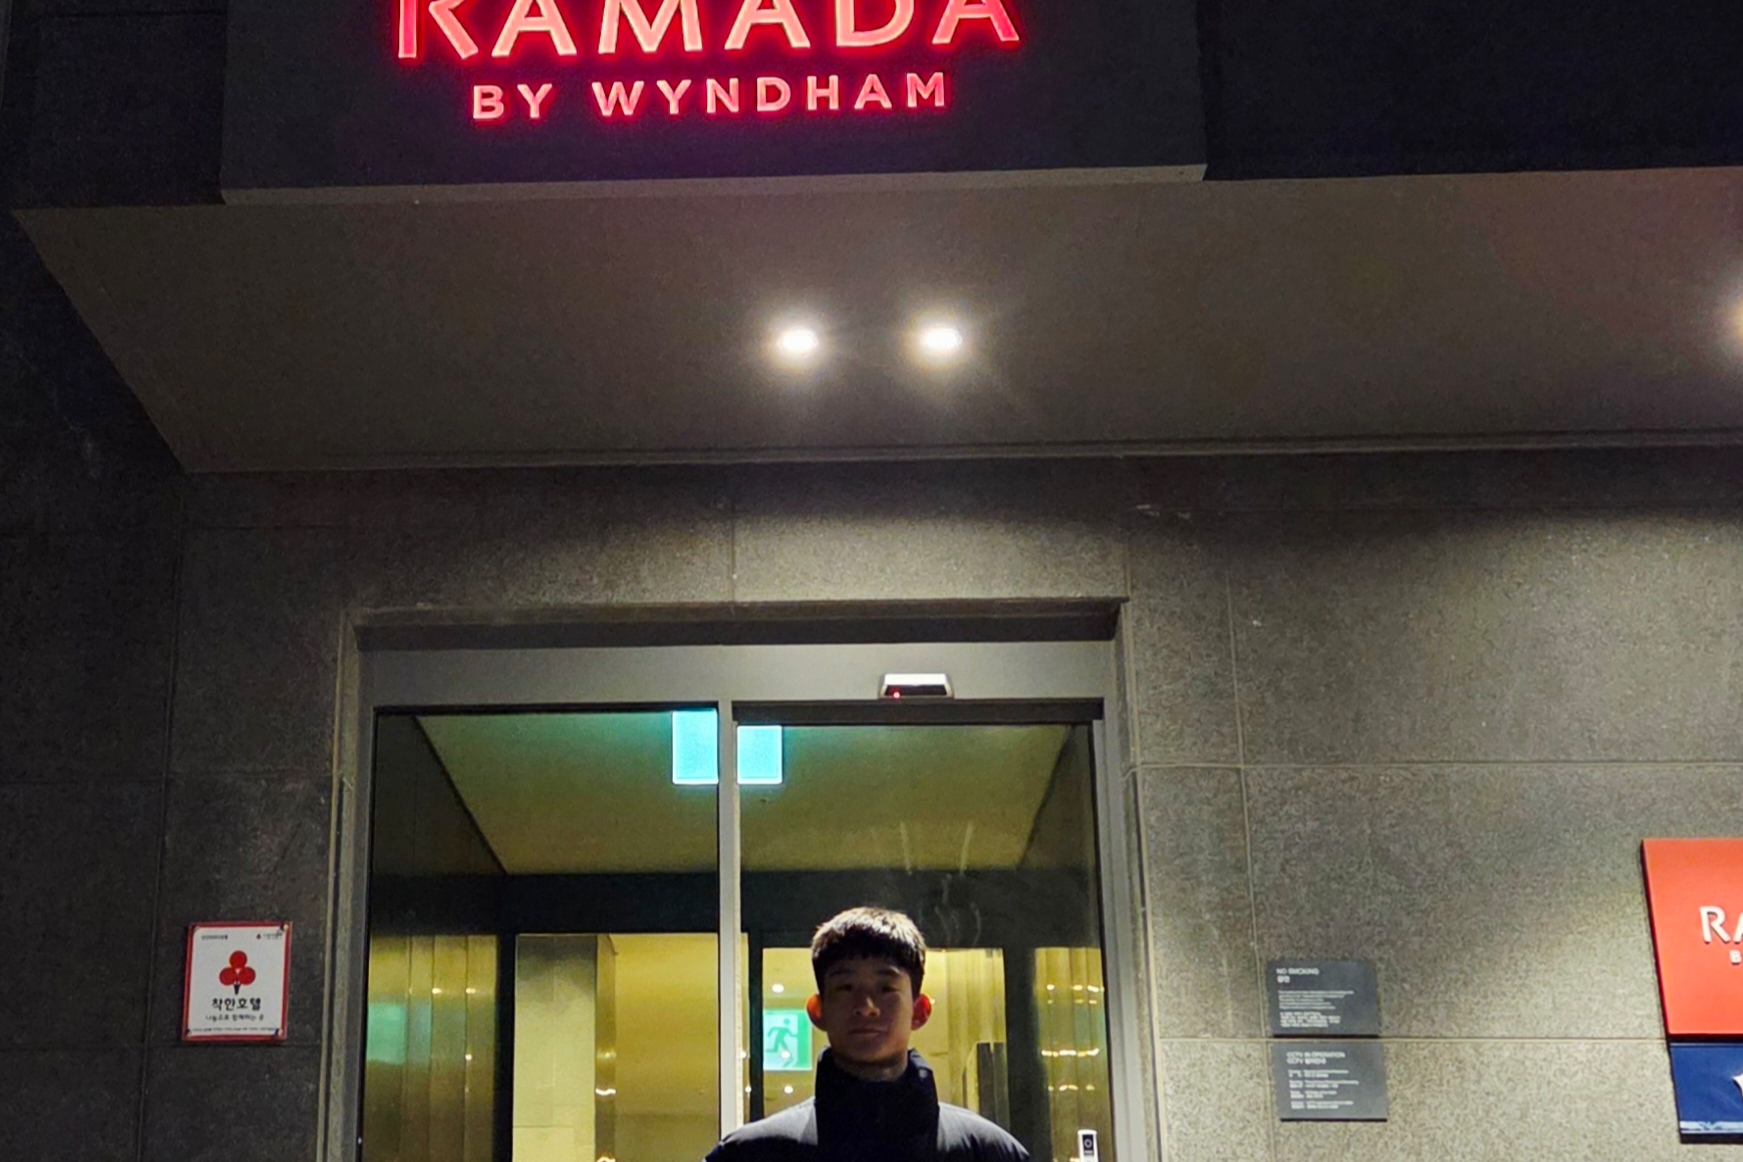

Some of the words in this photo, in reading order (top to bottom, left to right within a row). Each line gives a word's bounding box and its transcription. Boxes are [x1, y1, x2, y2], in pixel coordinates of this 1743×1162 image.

[472, 82, 553, 120] BY
[592, 72, 947, 116] WYNDHAM
[1699, 905, 1743, 943] R
